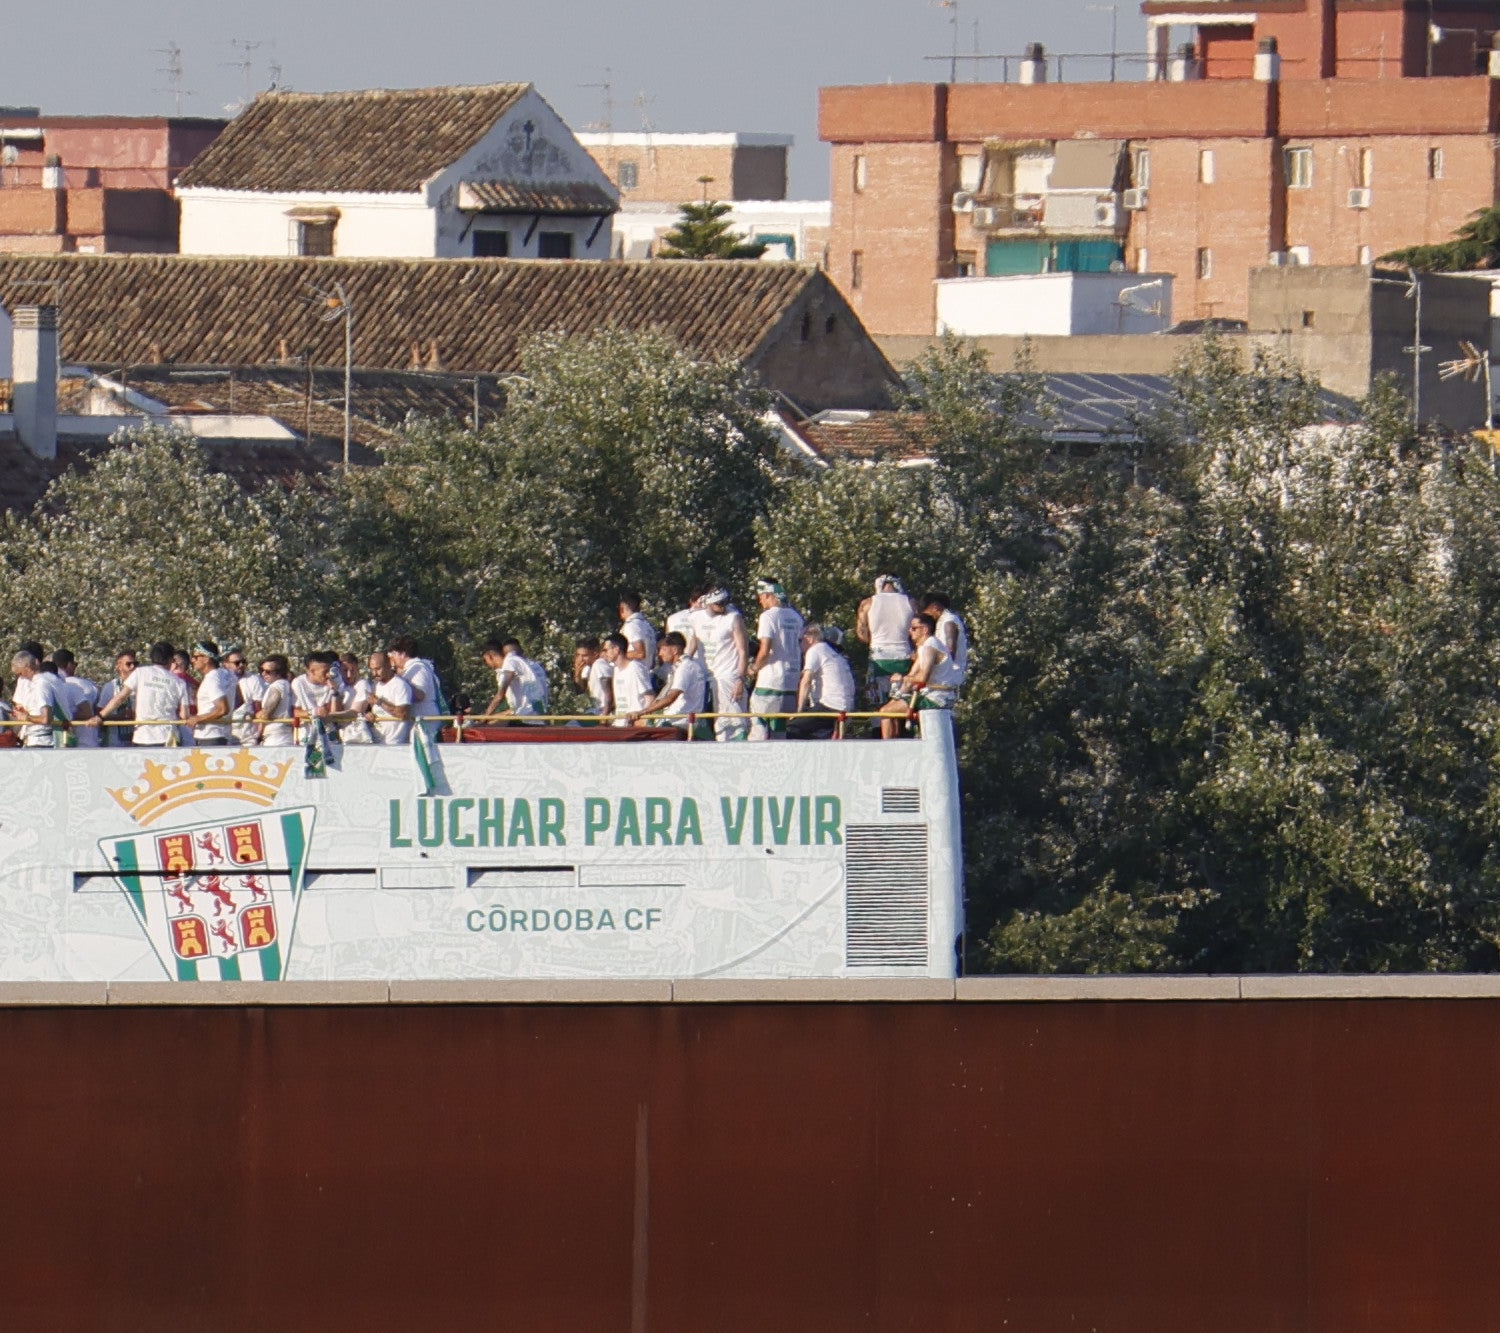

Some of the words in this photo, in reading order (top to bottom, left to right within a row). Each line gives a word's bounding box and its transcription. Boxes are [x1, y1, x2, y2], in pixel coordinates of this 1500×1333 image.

[389, 797, 567, 849] LUCHAR
[584, 797, 704, 847] PARA
[719, 795, 843, 846] VIVIR
[624, 907, 662, 931] CF
